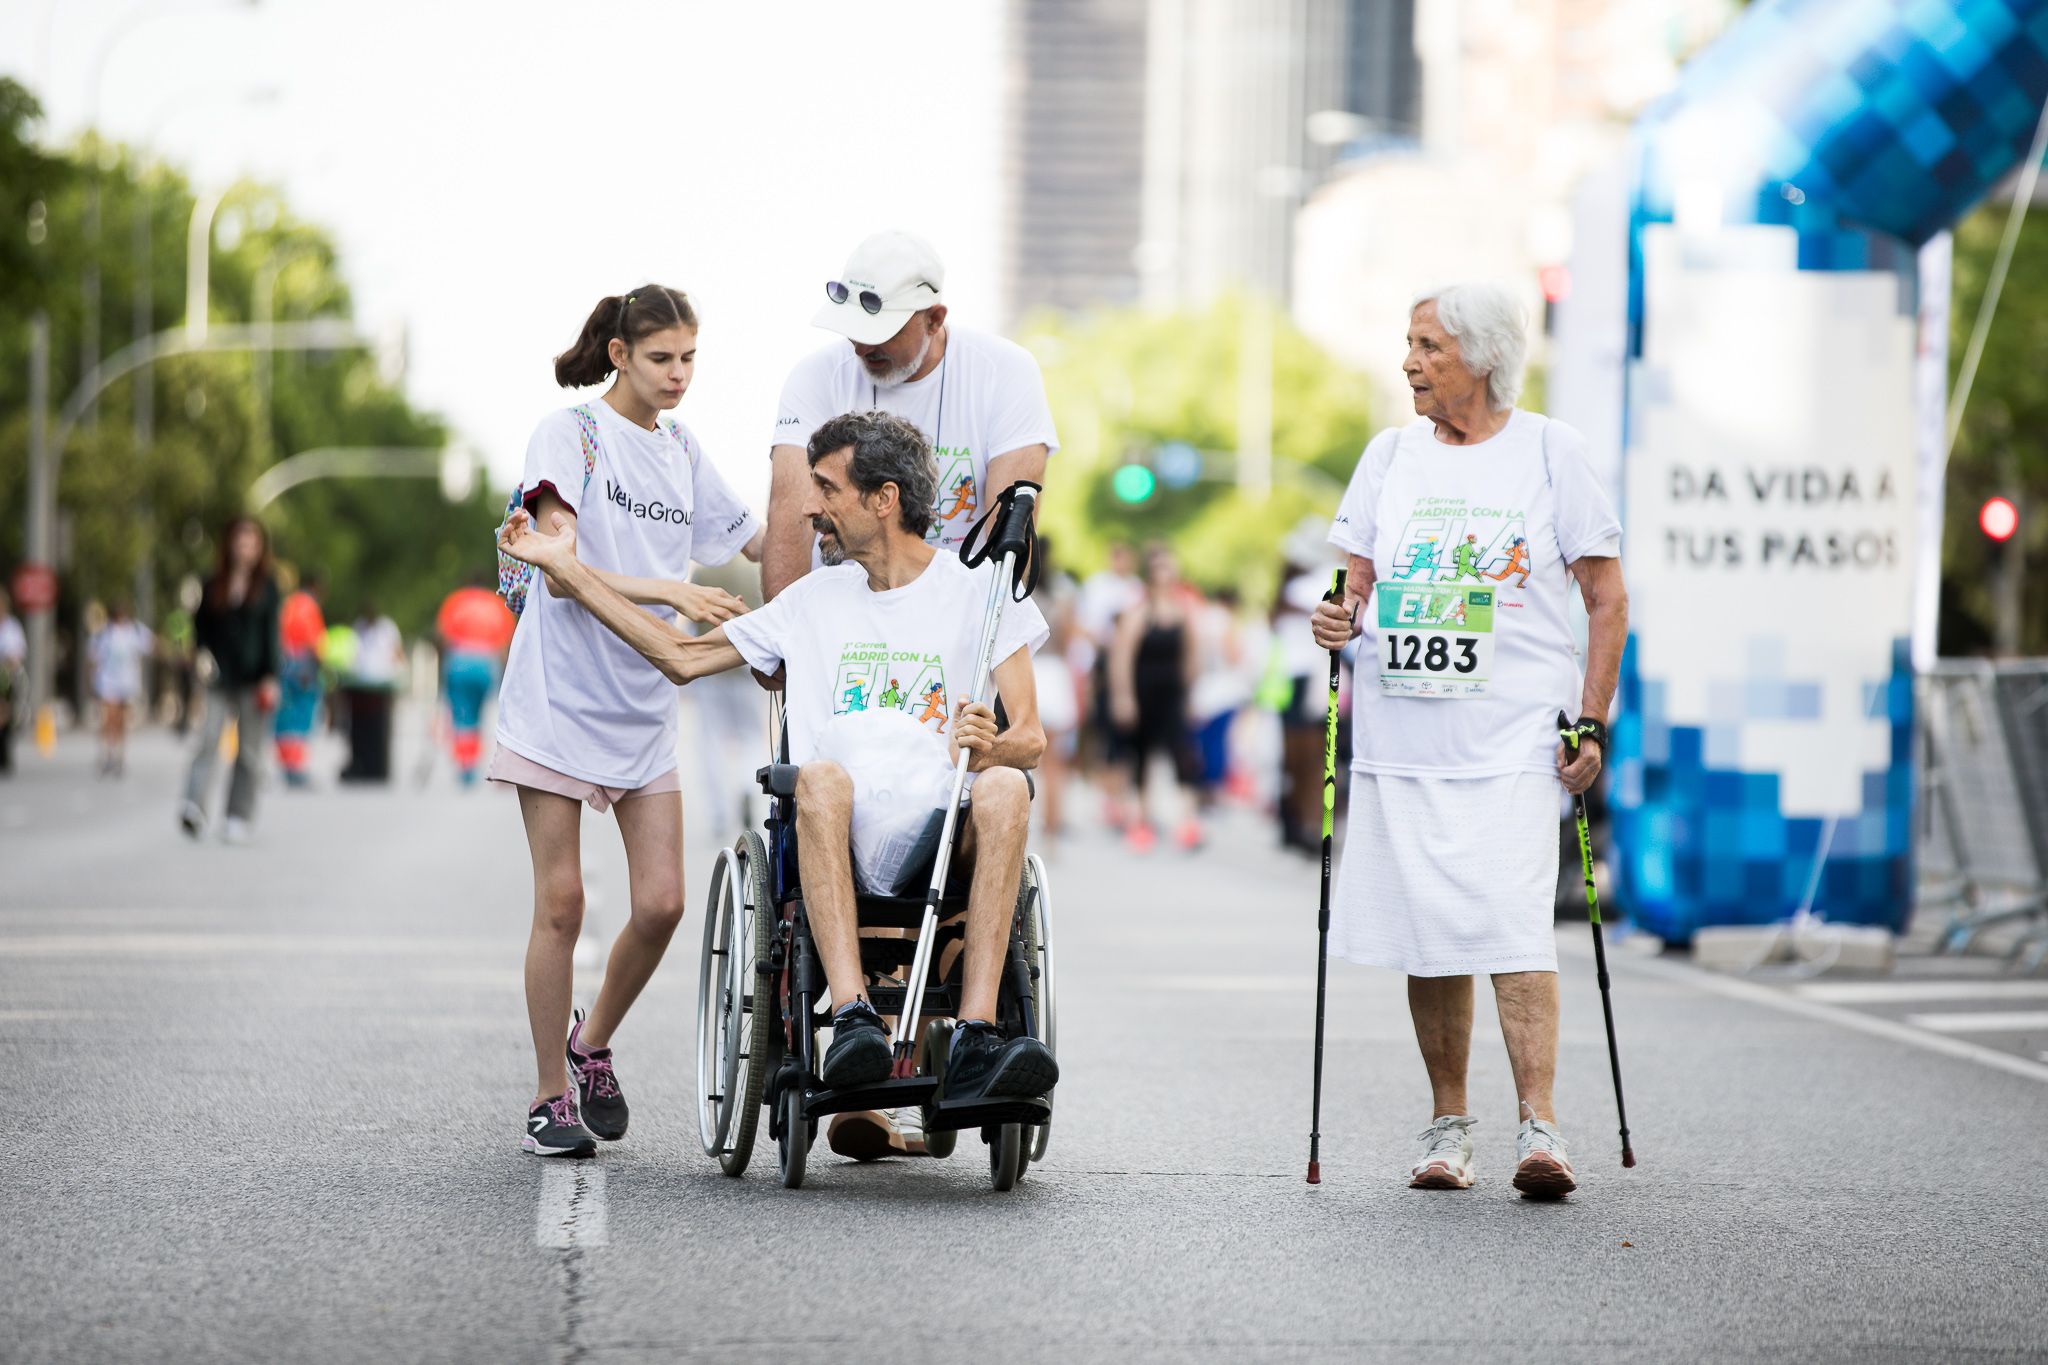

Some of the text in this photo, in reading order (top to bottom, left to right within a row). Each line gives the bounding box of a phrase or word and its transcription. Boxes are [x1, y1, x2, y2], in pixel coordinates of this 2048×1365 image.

[953, 447, 970, 456] LA
[1428, 496, 1467, 505] Carrera
[1668, 466, 1897, 502] DA VIDA A
[1411, 507, 1525, 520] MADRID CON LA
[1393, 518, 1531, 574] ELA
[1662, 530, 1742, 566] TUS
[1397, 593, 1466, 626] ELA
[840, 651, 942, 664] MADRID CON LA
[1387, 634, 1479, 674] 1283
